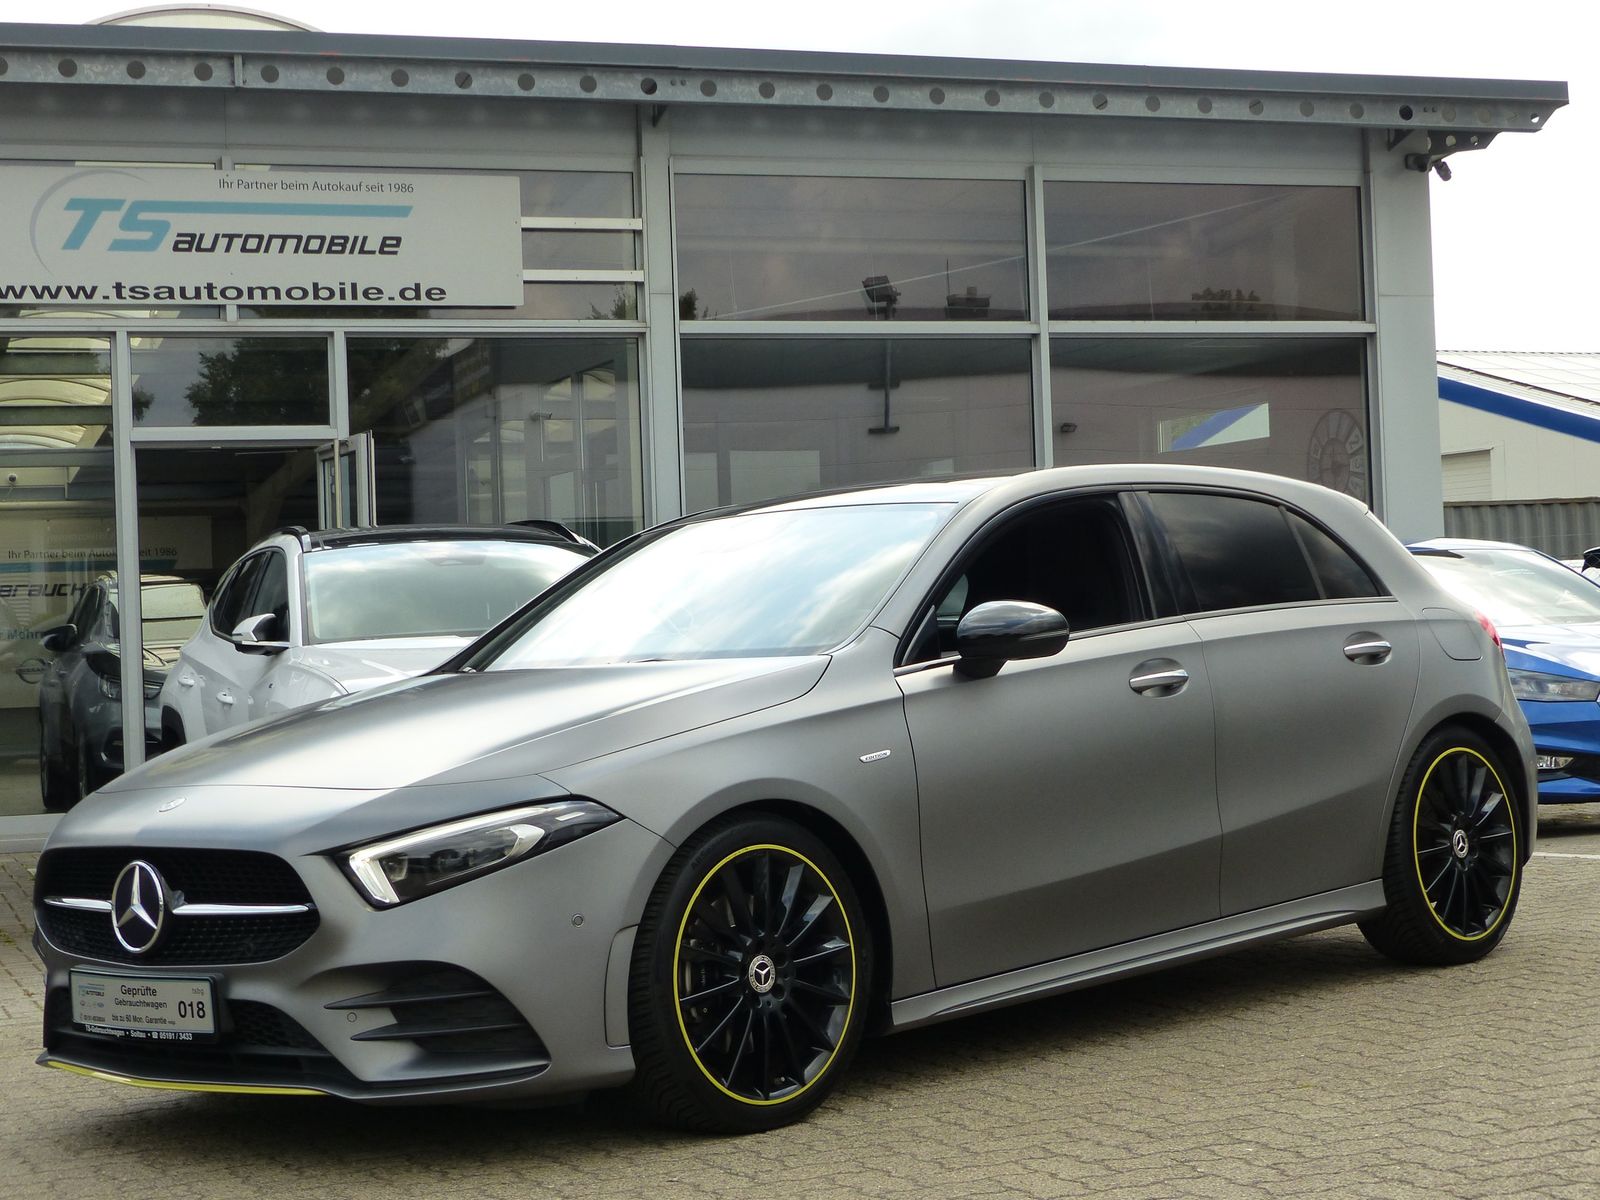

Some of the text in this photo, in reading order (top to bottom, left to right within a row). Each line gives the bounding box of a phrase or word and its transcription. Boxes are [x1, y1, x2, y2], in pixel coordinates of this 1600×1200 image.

[218, 179, 414, 193] Ihr Partner beim Autokauf seit 1986
[61, 198, 171, 252] TS
[0, 281, 447, 301] www.tsautomobile.de
[8, 550, 22, 560] Ihr
[24, 550, 59, 560] Partner
[120, 985, 158, 998] Geprüfte
[114, 998, 168, 1010] Gebrauchtwagen
[177, 1000, 206, 1019] 018
[145, 1016, 167, 1025] Garantie
[179, 1033, 193, 1041] 3433
